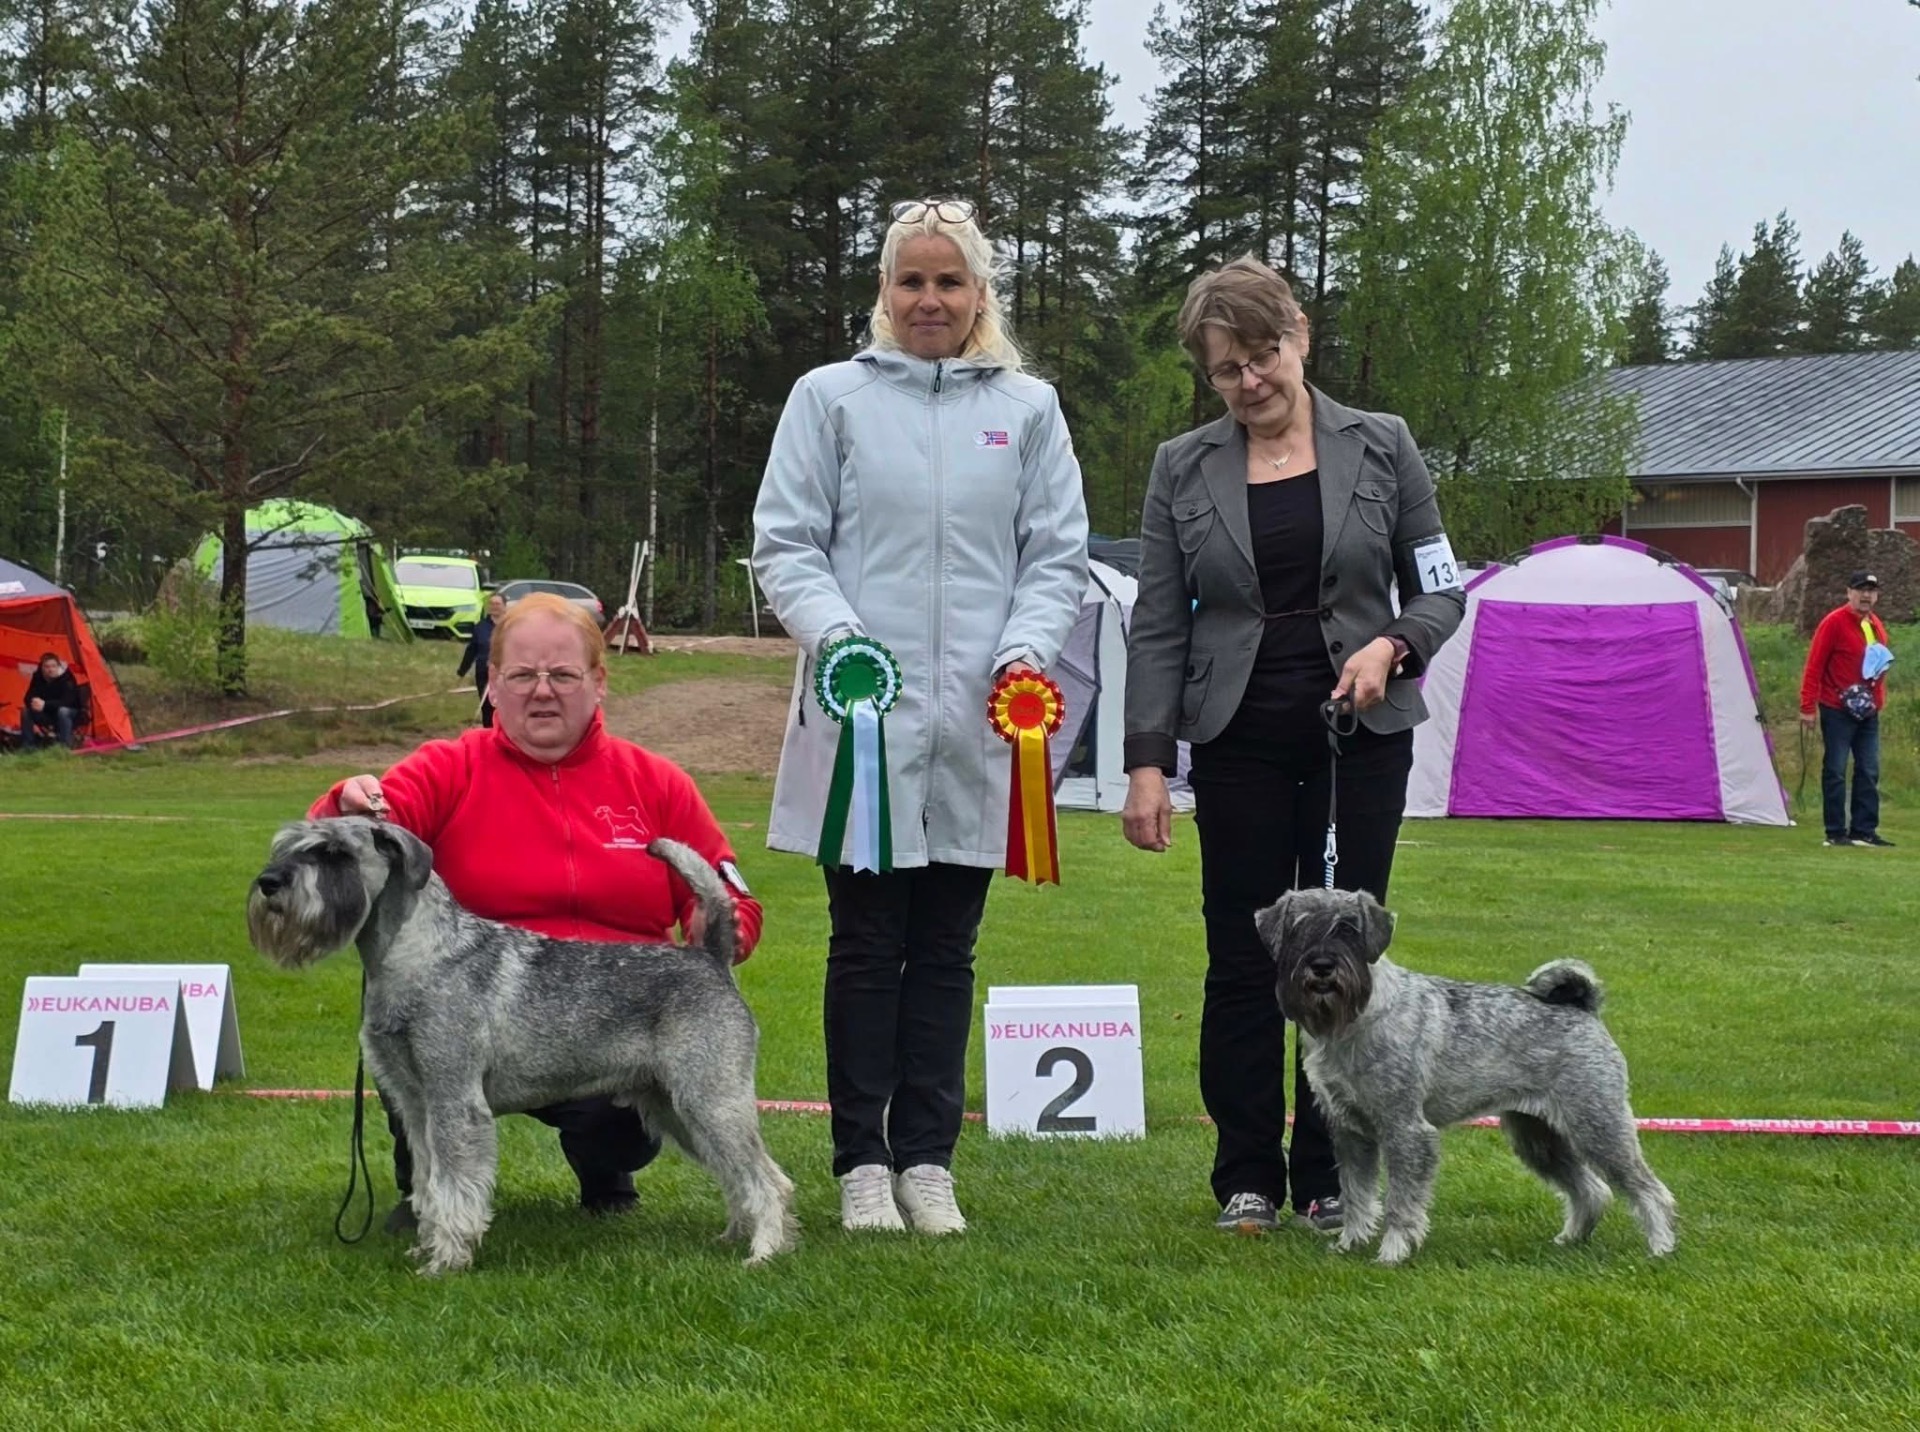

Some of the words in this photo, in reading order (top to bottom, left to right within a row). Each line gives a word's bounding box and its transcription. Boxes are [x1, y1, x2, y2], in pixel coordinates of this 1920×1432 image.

[41, 996, 170, 1012] EUKANUBA
[1004, 1021, 1135, 1039] EUKANUBA
[75, 1020, 116, 1104] 1
[1035, 1046, 1097, 1133] 2
